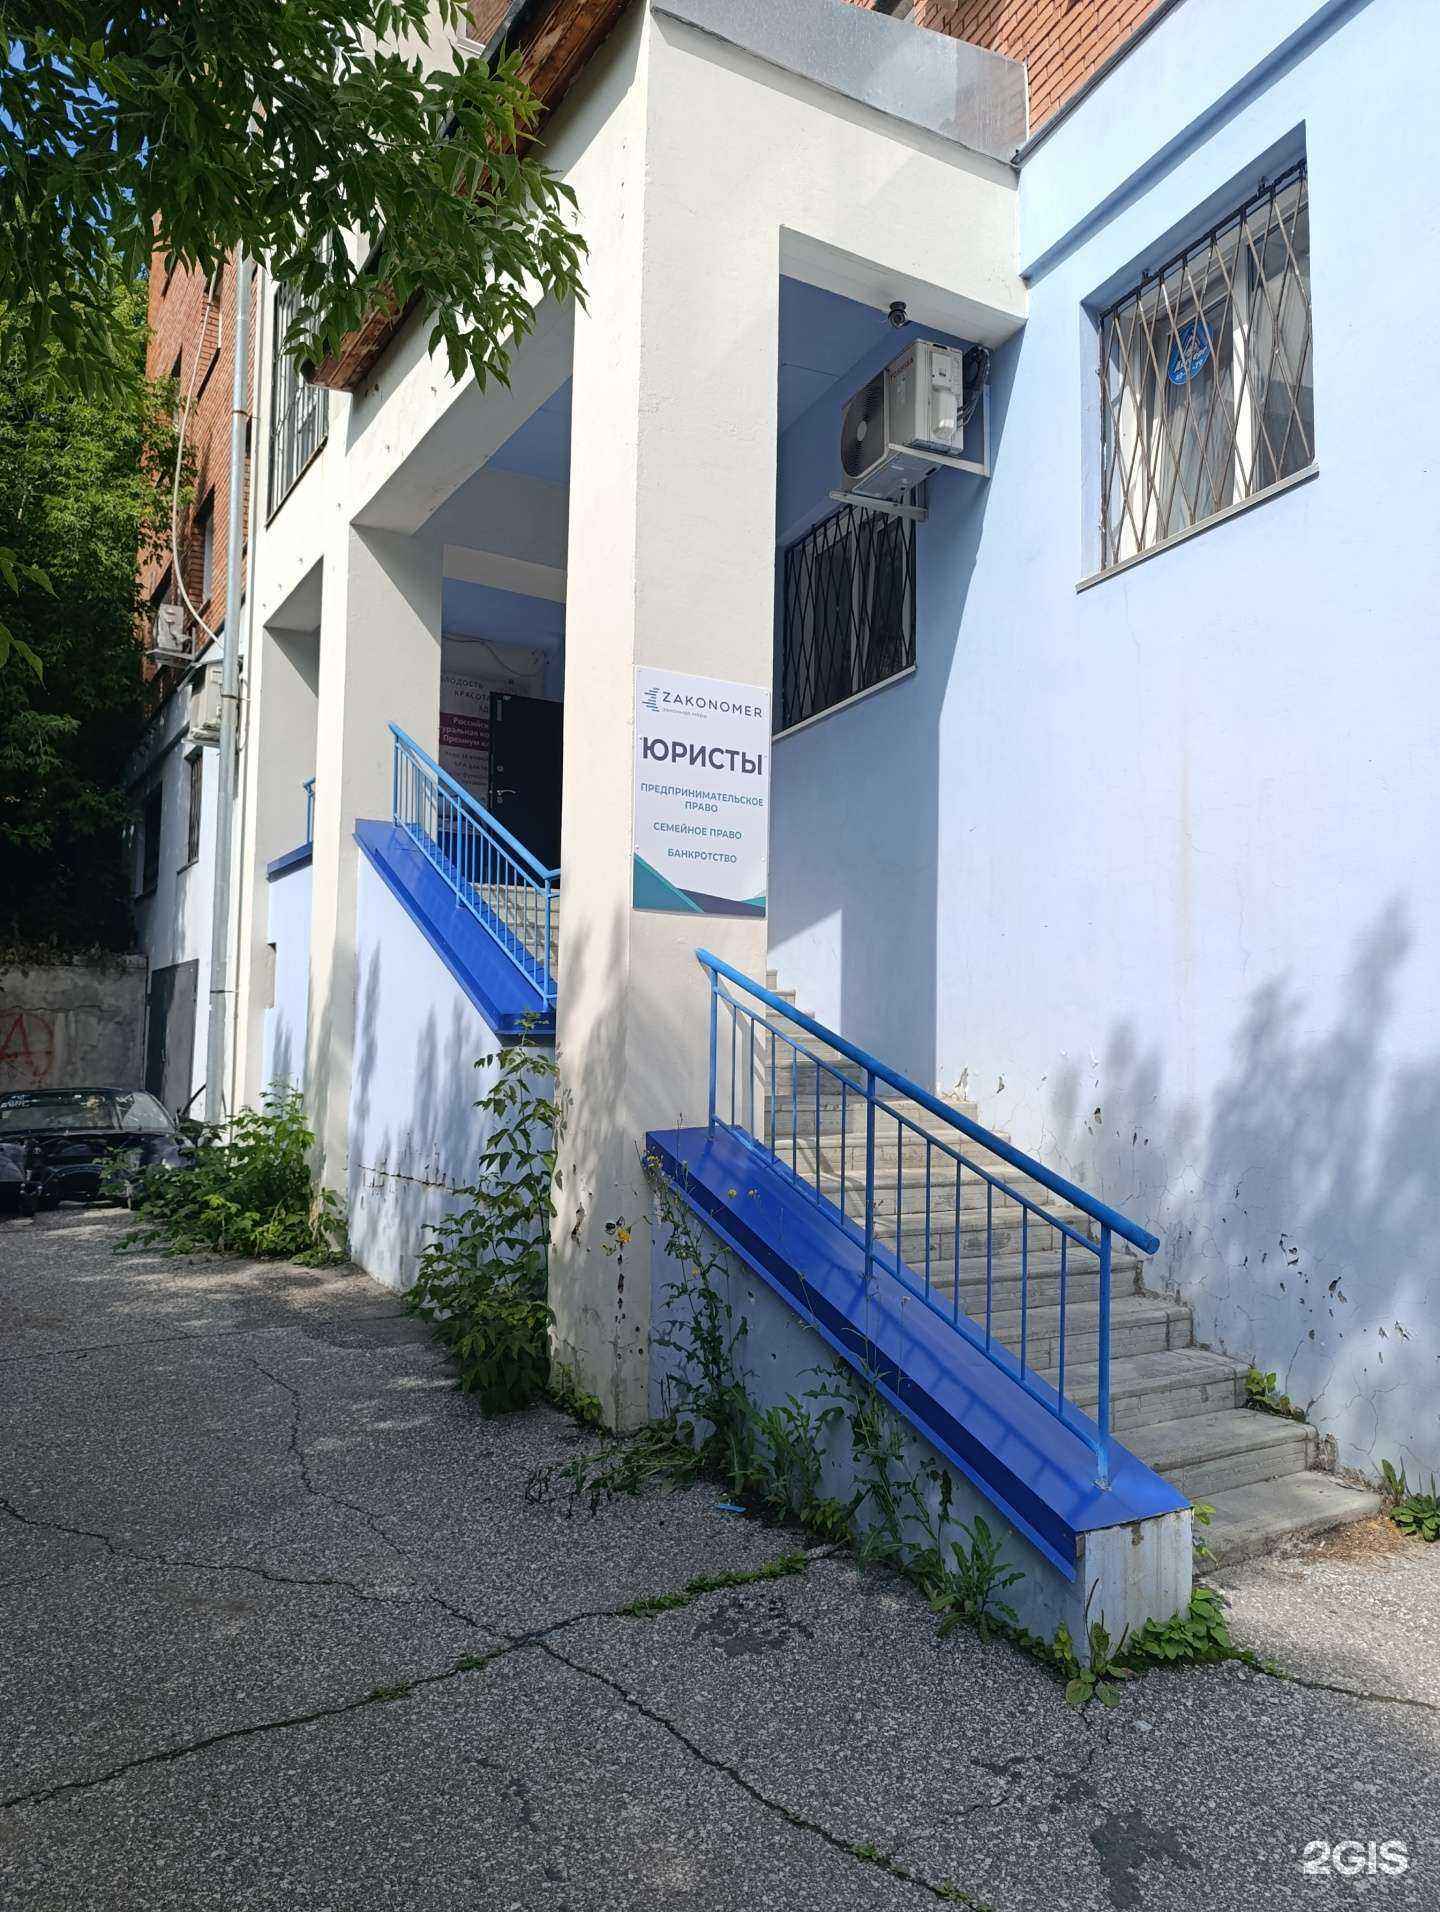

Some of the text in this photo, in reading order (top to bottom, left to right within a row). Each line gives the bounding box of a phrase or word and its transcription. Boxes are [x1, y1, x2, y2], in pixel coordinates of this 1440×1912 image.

[662, 691, 762, 718] ZAKONOMER
[643, 737, 762, 775] ЮРИСТЫ
[640, 783, 764, 807] ПРЕДПРИНИМАТЕЛЬСКОЕ
[685, 801, 718, 813] ПРАВО
[653, 822, 742, 840] СЕМЕЙНОЕ ПРАВО
[667, 848, 737, 864] БАНКРОТСТВО
